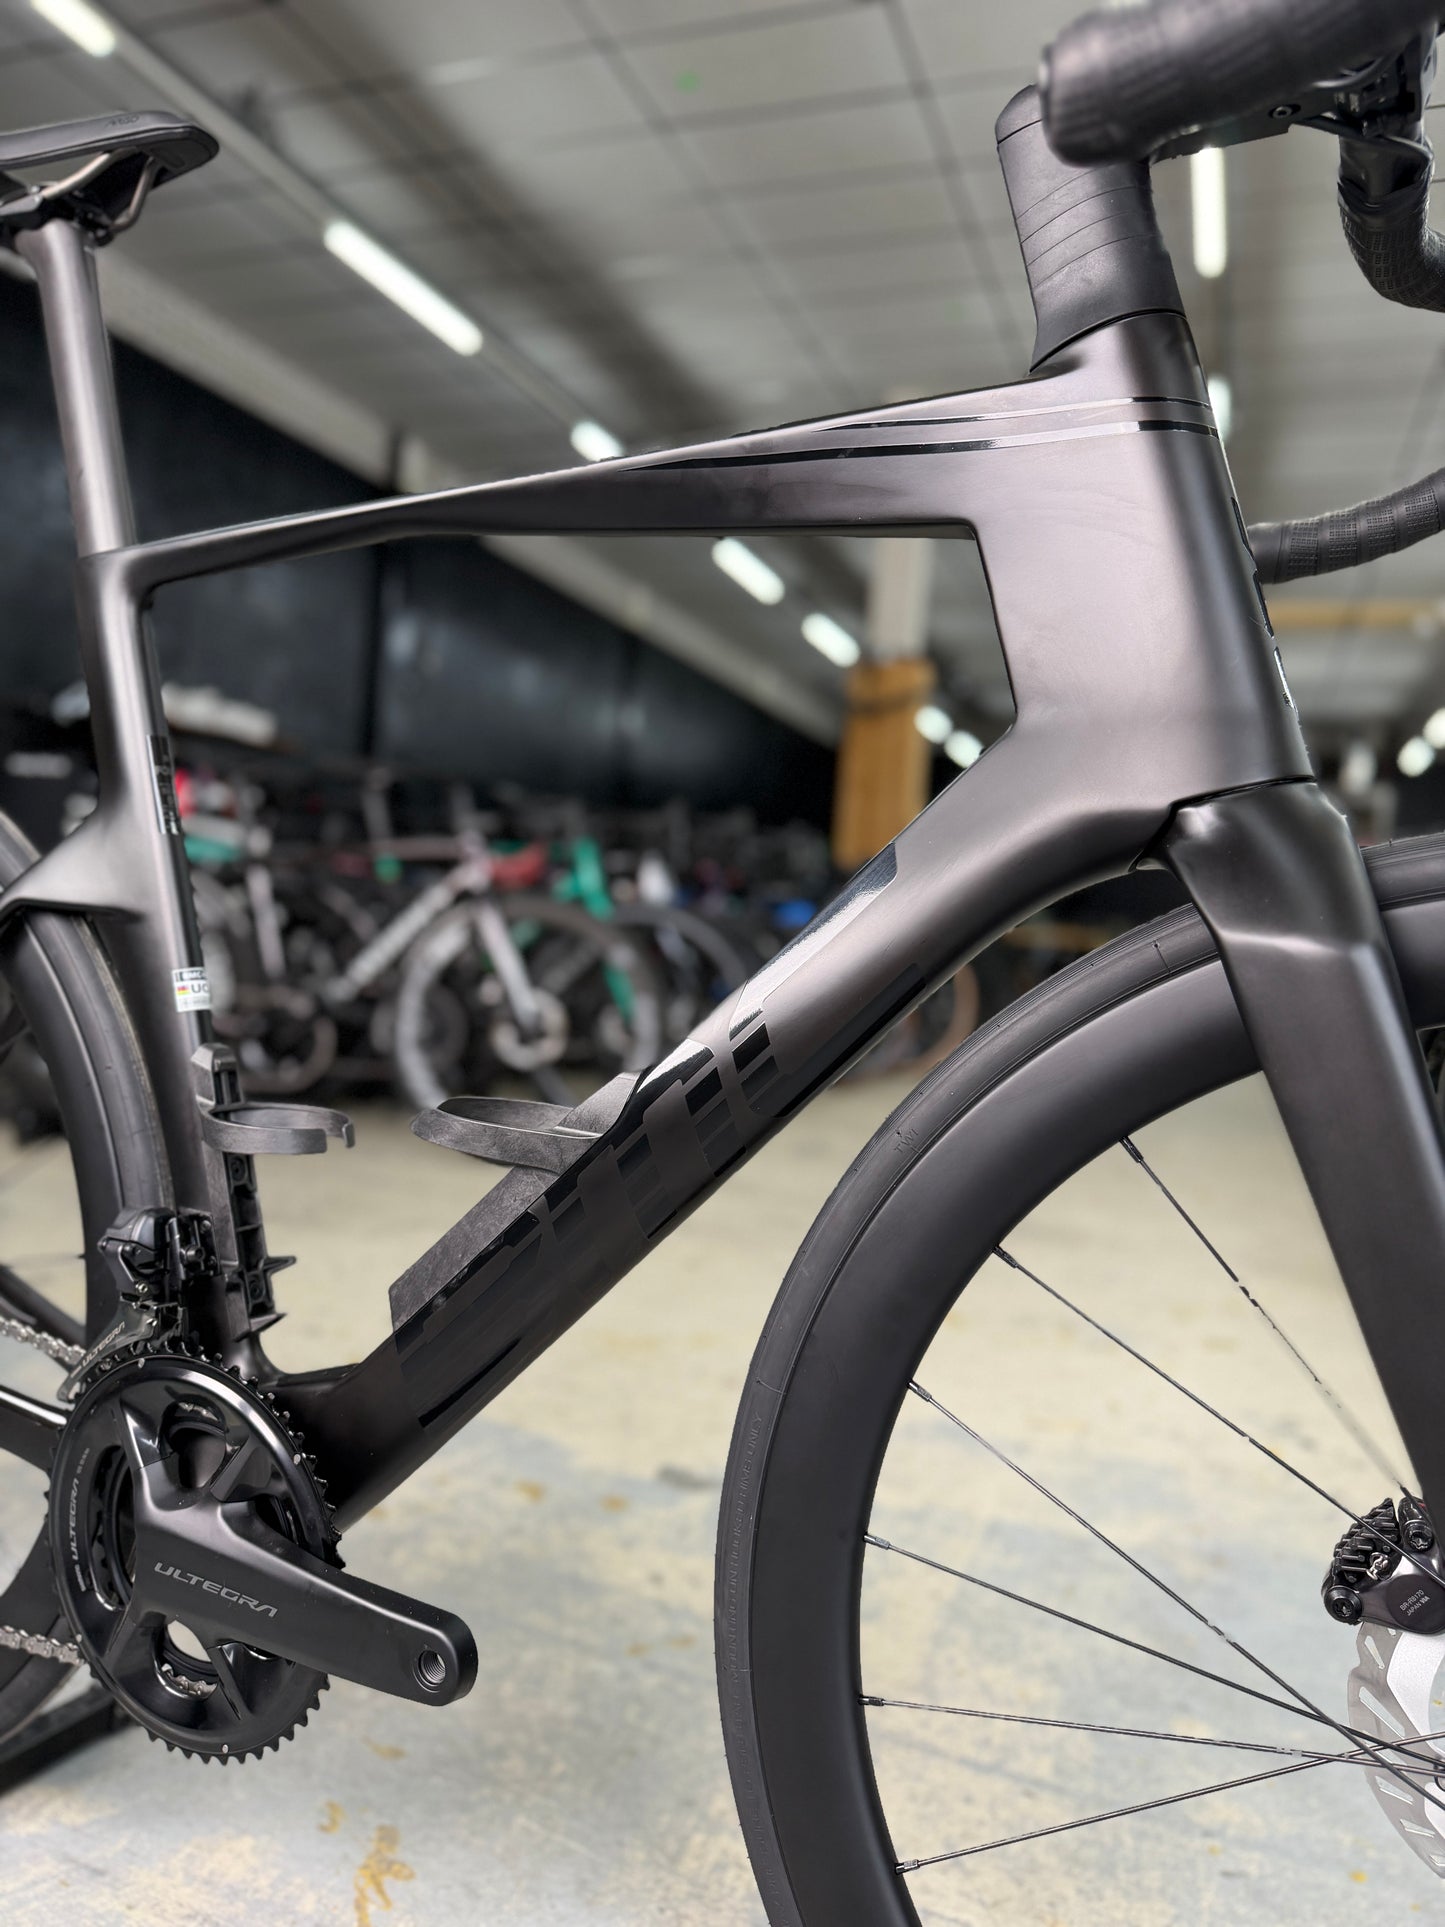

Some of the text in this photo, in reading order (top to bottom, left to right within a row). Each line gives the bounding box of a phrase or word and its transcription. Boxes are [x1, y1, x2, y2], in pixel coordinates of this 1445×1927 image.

[82, 1321, 125, 1367] ULTEGRA
[69, 1477, 80, 1561] ULTEGRA
[154, 1562, 278, 1618] ULTEGRA
[1407, 1602, 1421, 1616] JAPAN
